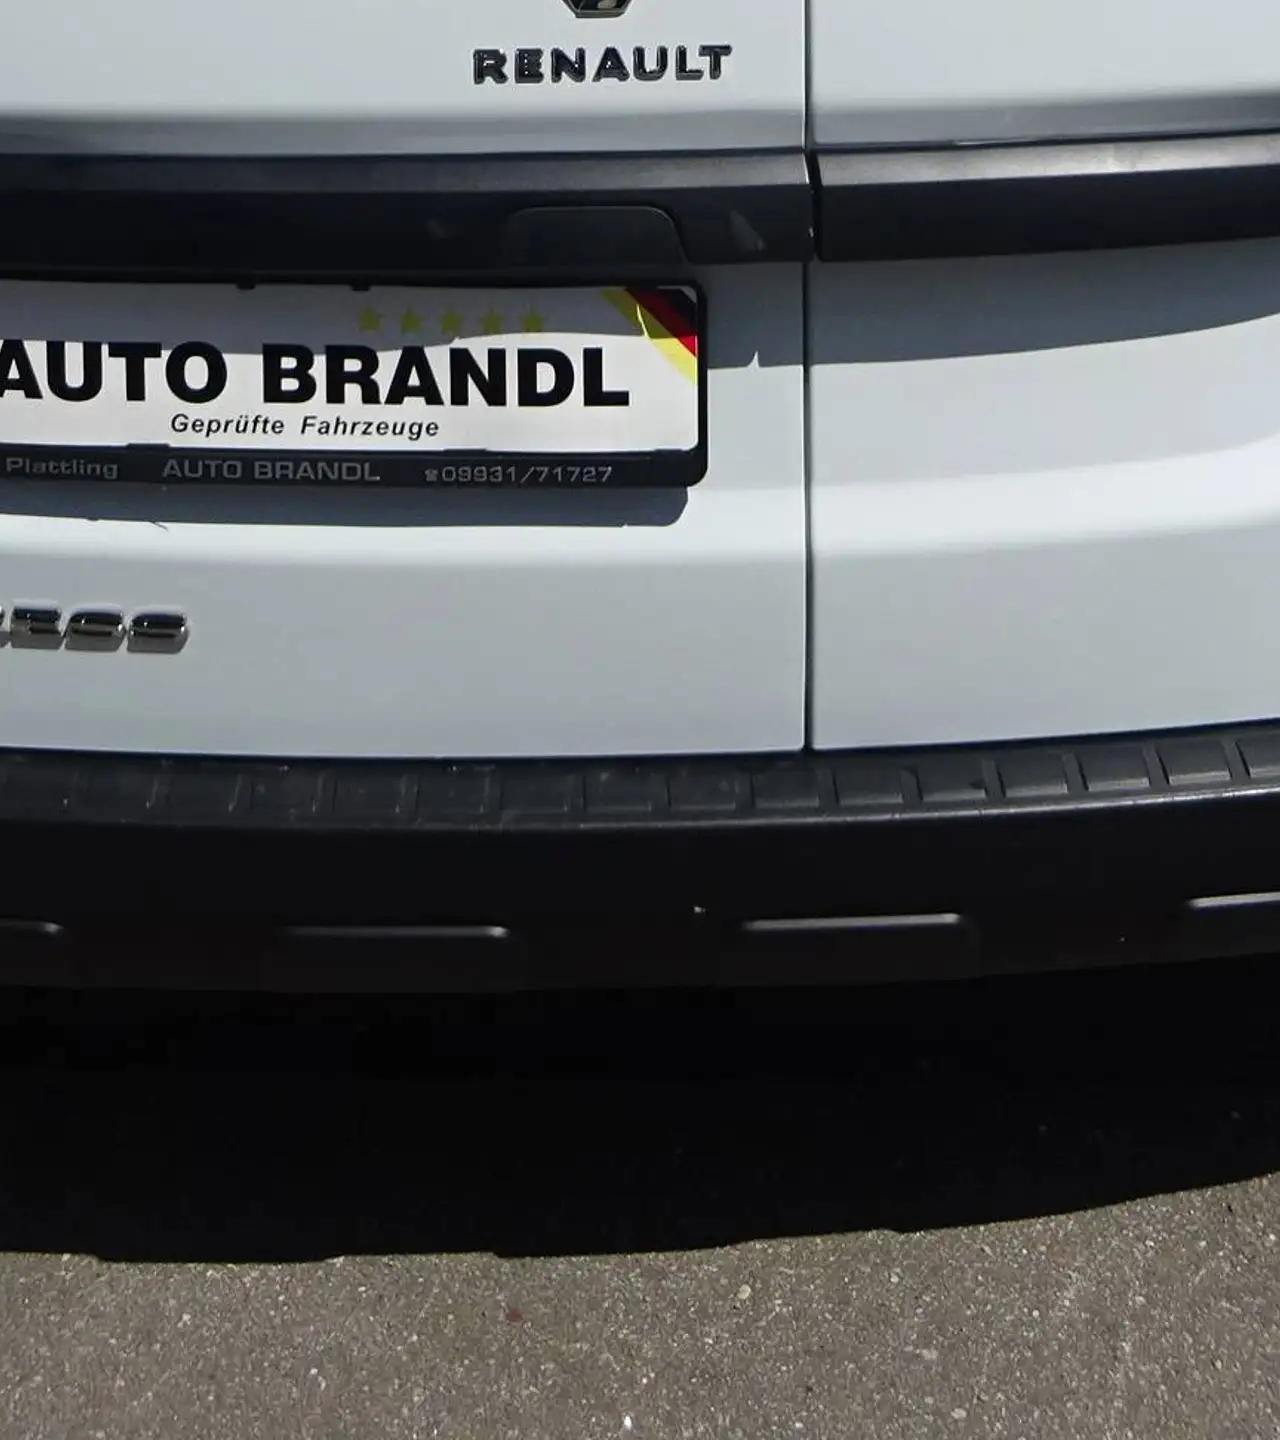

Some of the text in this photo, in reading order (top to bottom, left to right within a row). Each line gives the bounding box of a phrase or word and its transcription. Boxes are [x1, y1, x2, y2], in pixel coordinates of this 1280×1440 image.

[472, 44, 733, 85] RENAULT
[262, 343, 630, 408] BRANDL
[170, 413, 440, 439] Geprüfte Fahrzeuge
[5, 456, 119, 480] Plattling
[162, 459, 242, 479] AUTO
[253, 460, 381, 482] BRANDL
